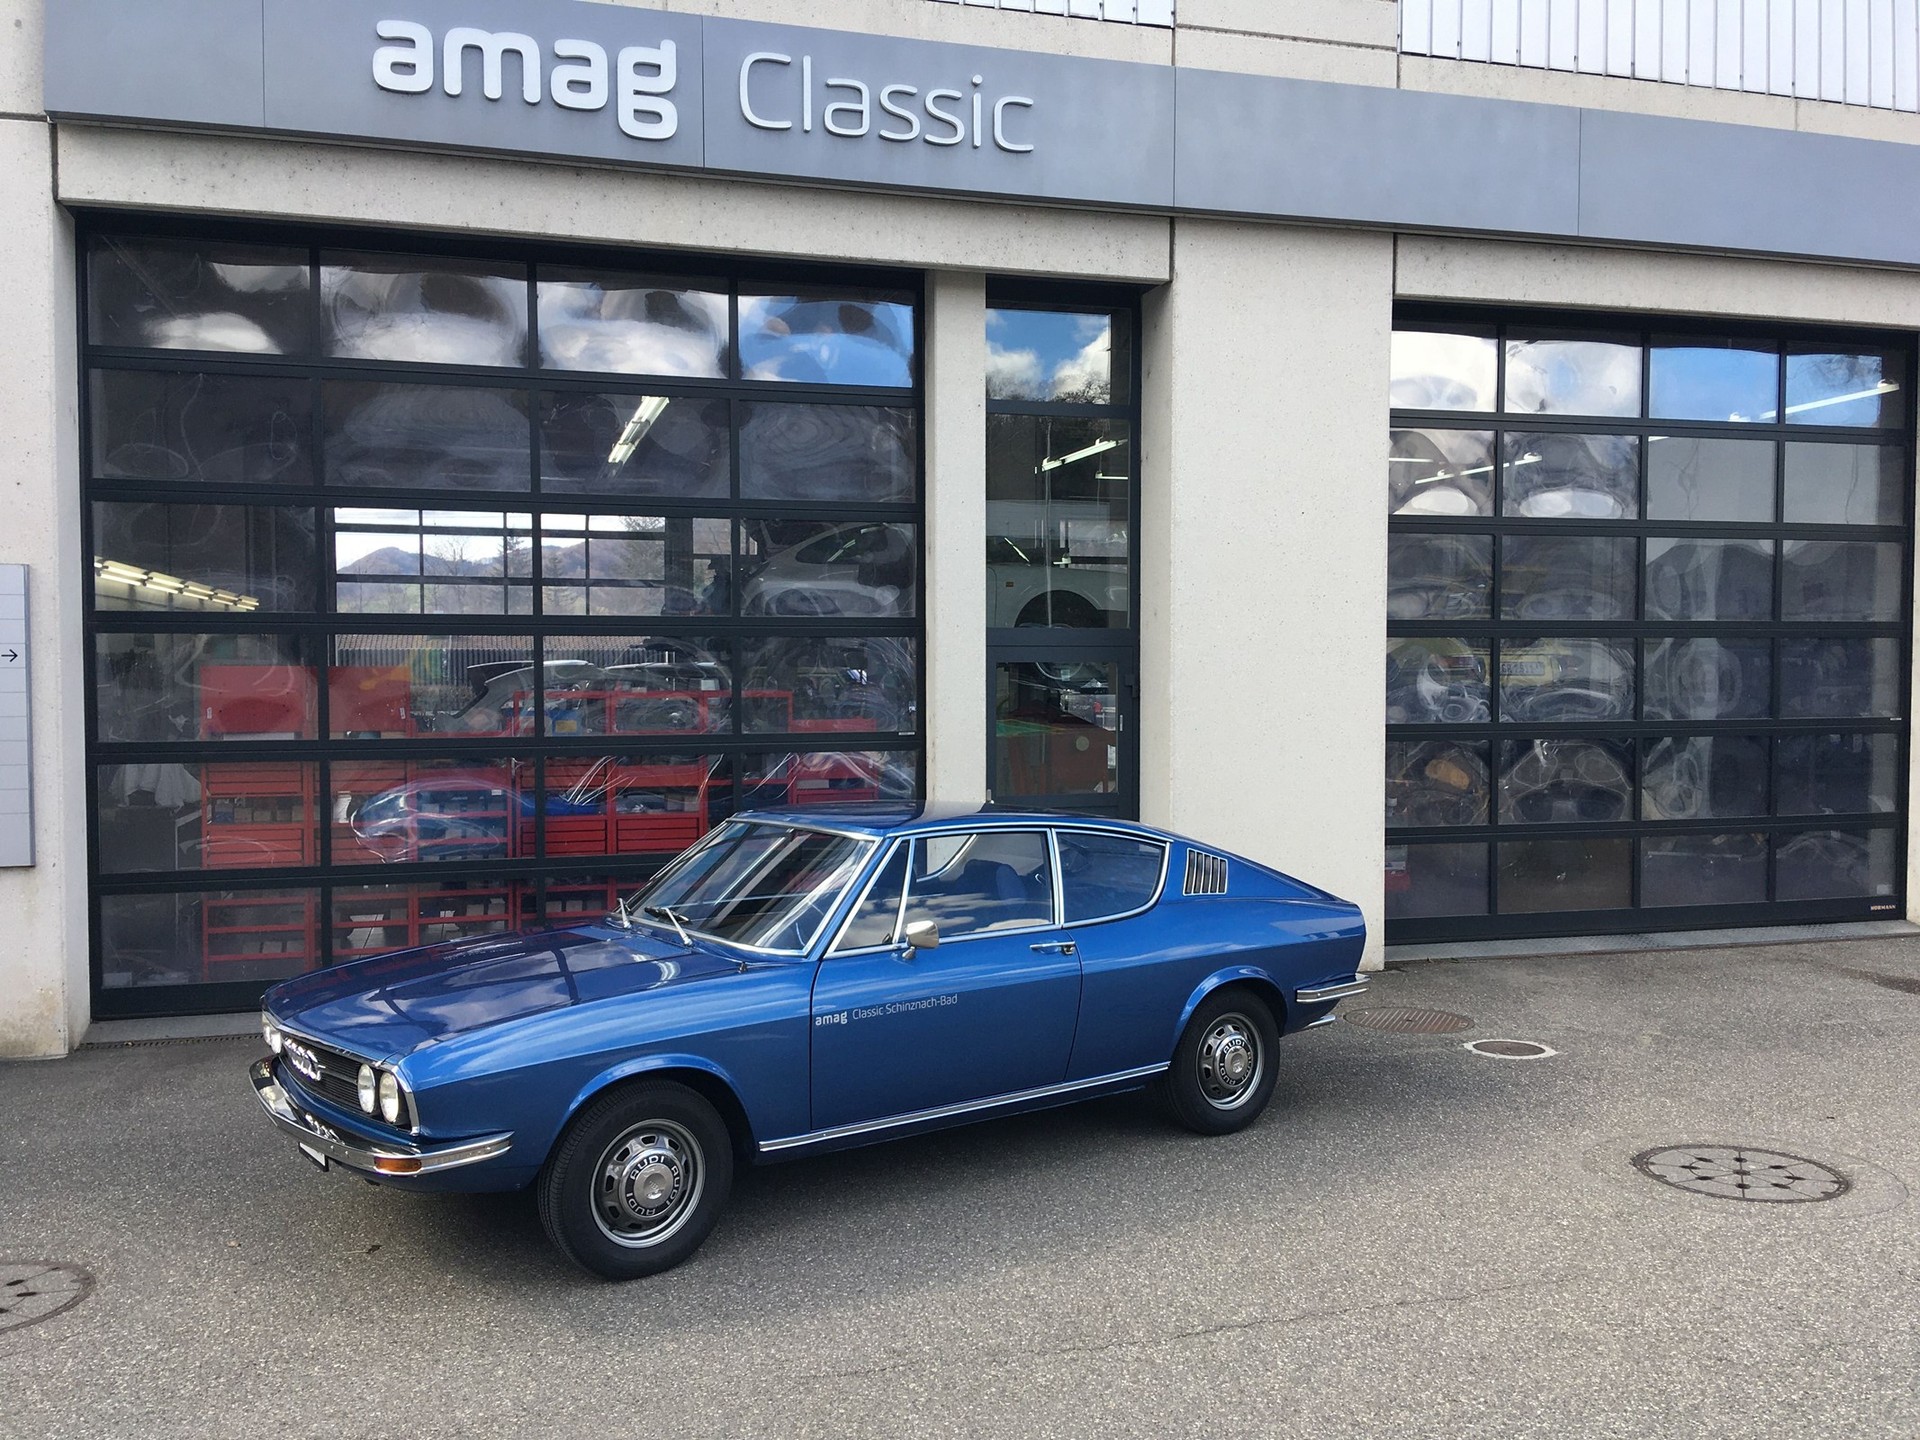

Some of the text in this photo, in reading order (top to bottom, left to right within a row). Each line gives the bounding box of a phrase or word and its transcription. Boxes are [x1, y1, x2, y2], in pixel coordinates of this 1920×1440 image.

[372, 19, 1034, 152] amag Classic
[815, 993, 958, 1026] amag Classic Schinznach-Bad
[1223, 1039, 1245, 1054] AUDI
[630, 1155, 665, 1180] AUDI
[665, 1165, 680, 1206] AUDI
[626, 1192, 655, 1216] AUDI
